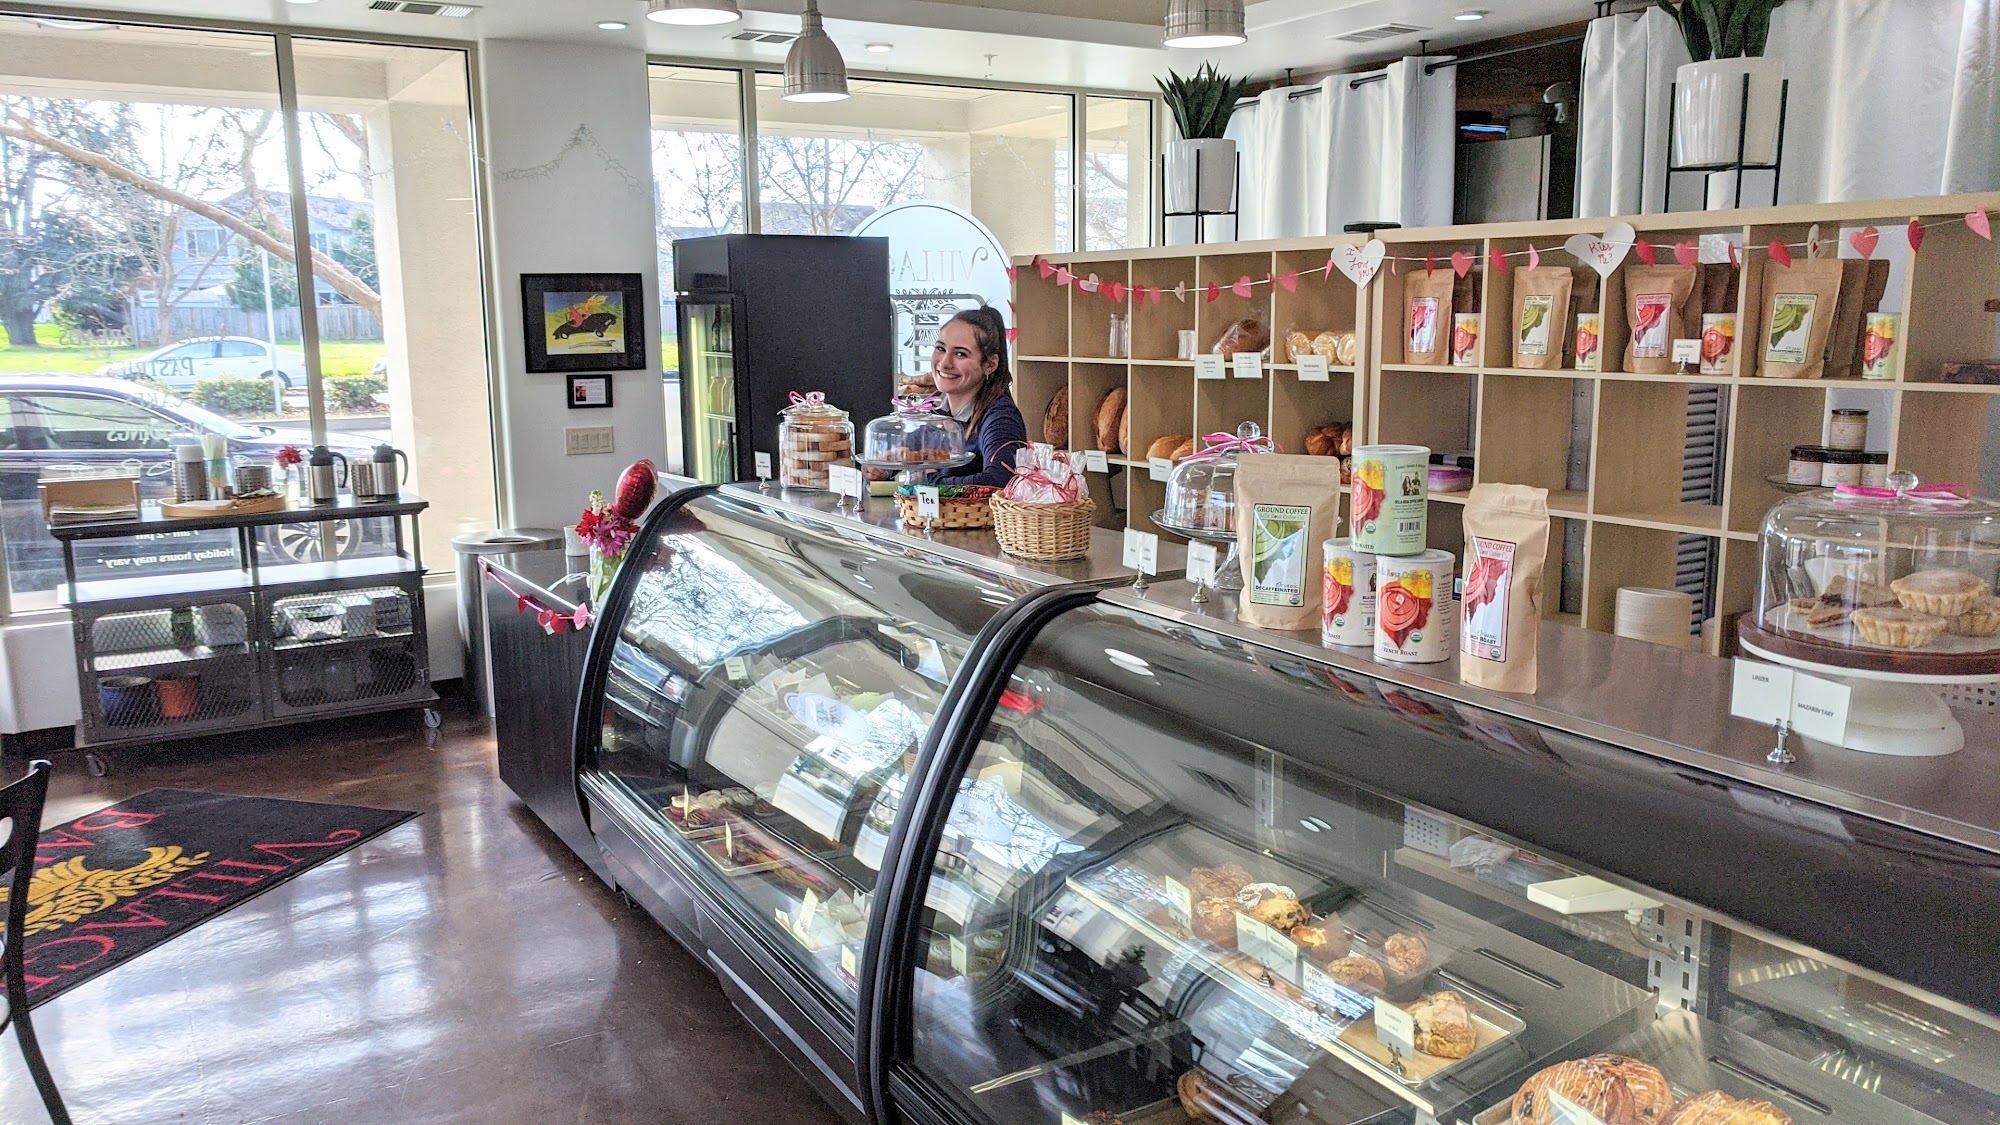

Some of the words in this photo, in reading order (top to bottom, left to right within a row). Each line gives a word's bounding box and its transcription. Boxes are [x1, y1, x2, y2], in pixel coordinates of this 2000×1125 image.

[1346, 248, 1355, 256] I
[1257, 506, 1285, 514] GROUND
[1285, 507, 1309, 515] COFFEE
[1492, 542, 1514, 553] COFFEE
[1255, 585, 1299, 594] DECAFFEINATED
[1399, 649, 1418, 657] ROAST
[1752, 674, 1769, 683] LINZER
[1797, 702, 1821, 713] MAZARIN
[1821, 709, 1835, 718] TART
